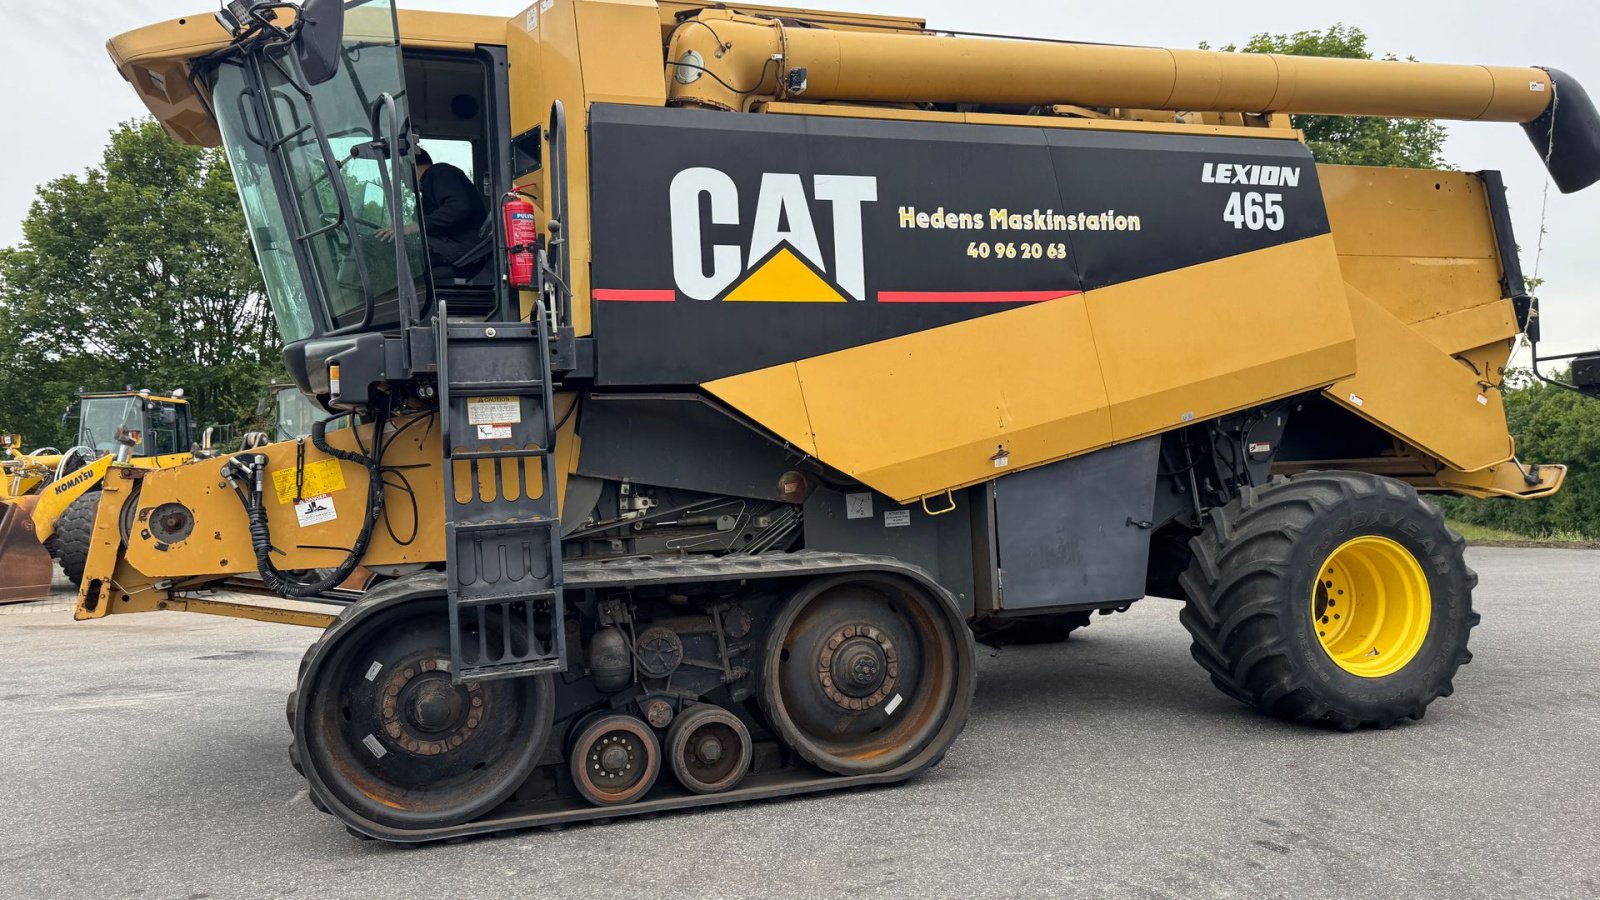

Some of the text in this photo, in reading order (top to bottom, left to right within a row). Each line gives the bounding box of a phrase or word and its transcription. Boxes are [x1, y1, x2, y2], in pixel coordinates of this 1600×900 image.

[1201, 162, 1301, 187] LEXION
[897, 206, 1142, 231] Hedens Maskinstation
[1223, 191, 1285, 231] 465
[669, 166, 878, 302] CAT
[966, 242, 1067, 260] 40 96 20 63
[54, 469, 94, 495] KOMATSU
